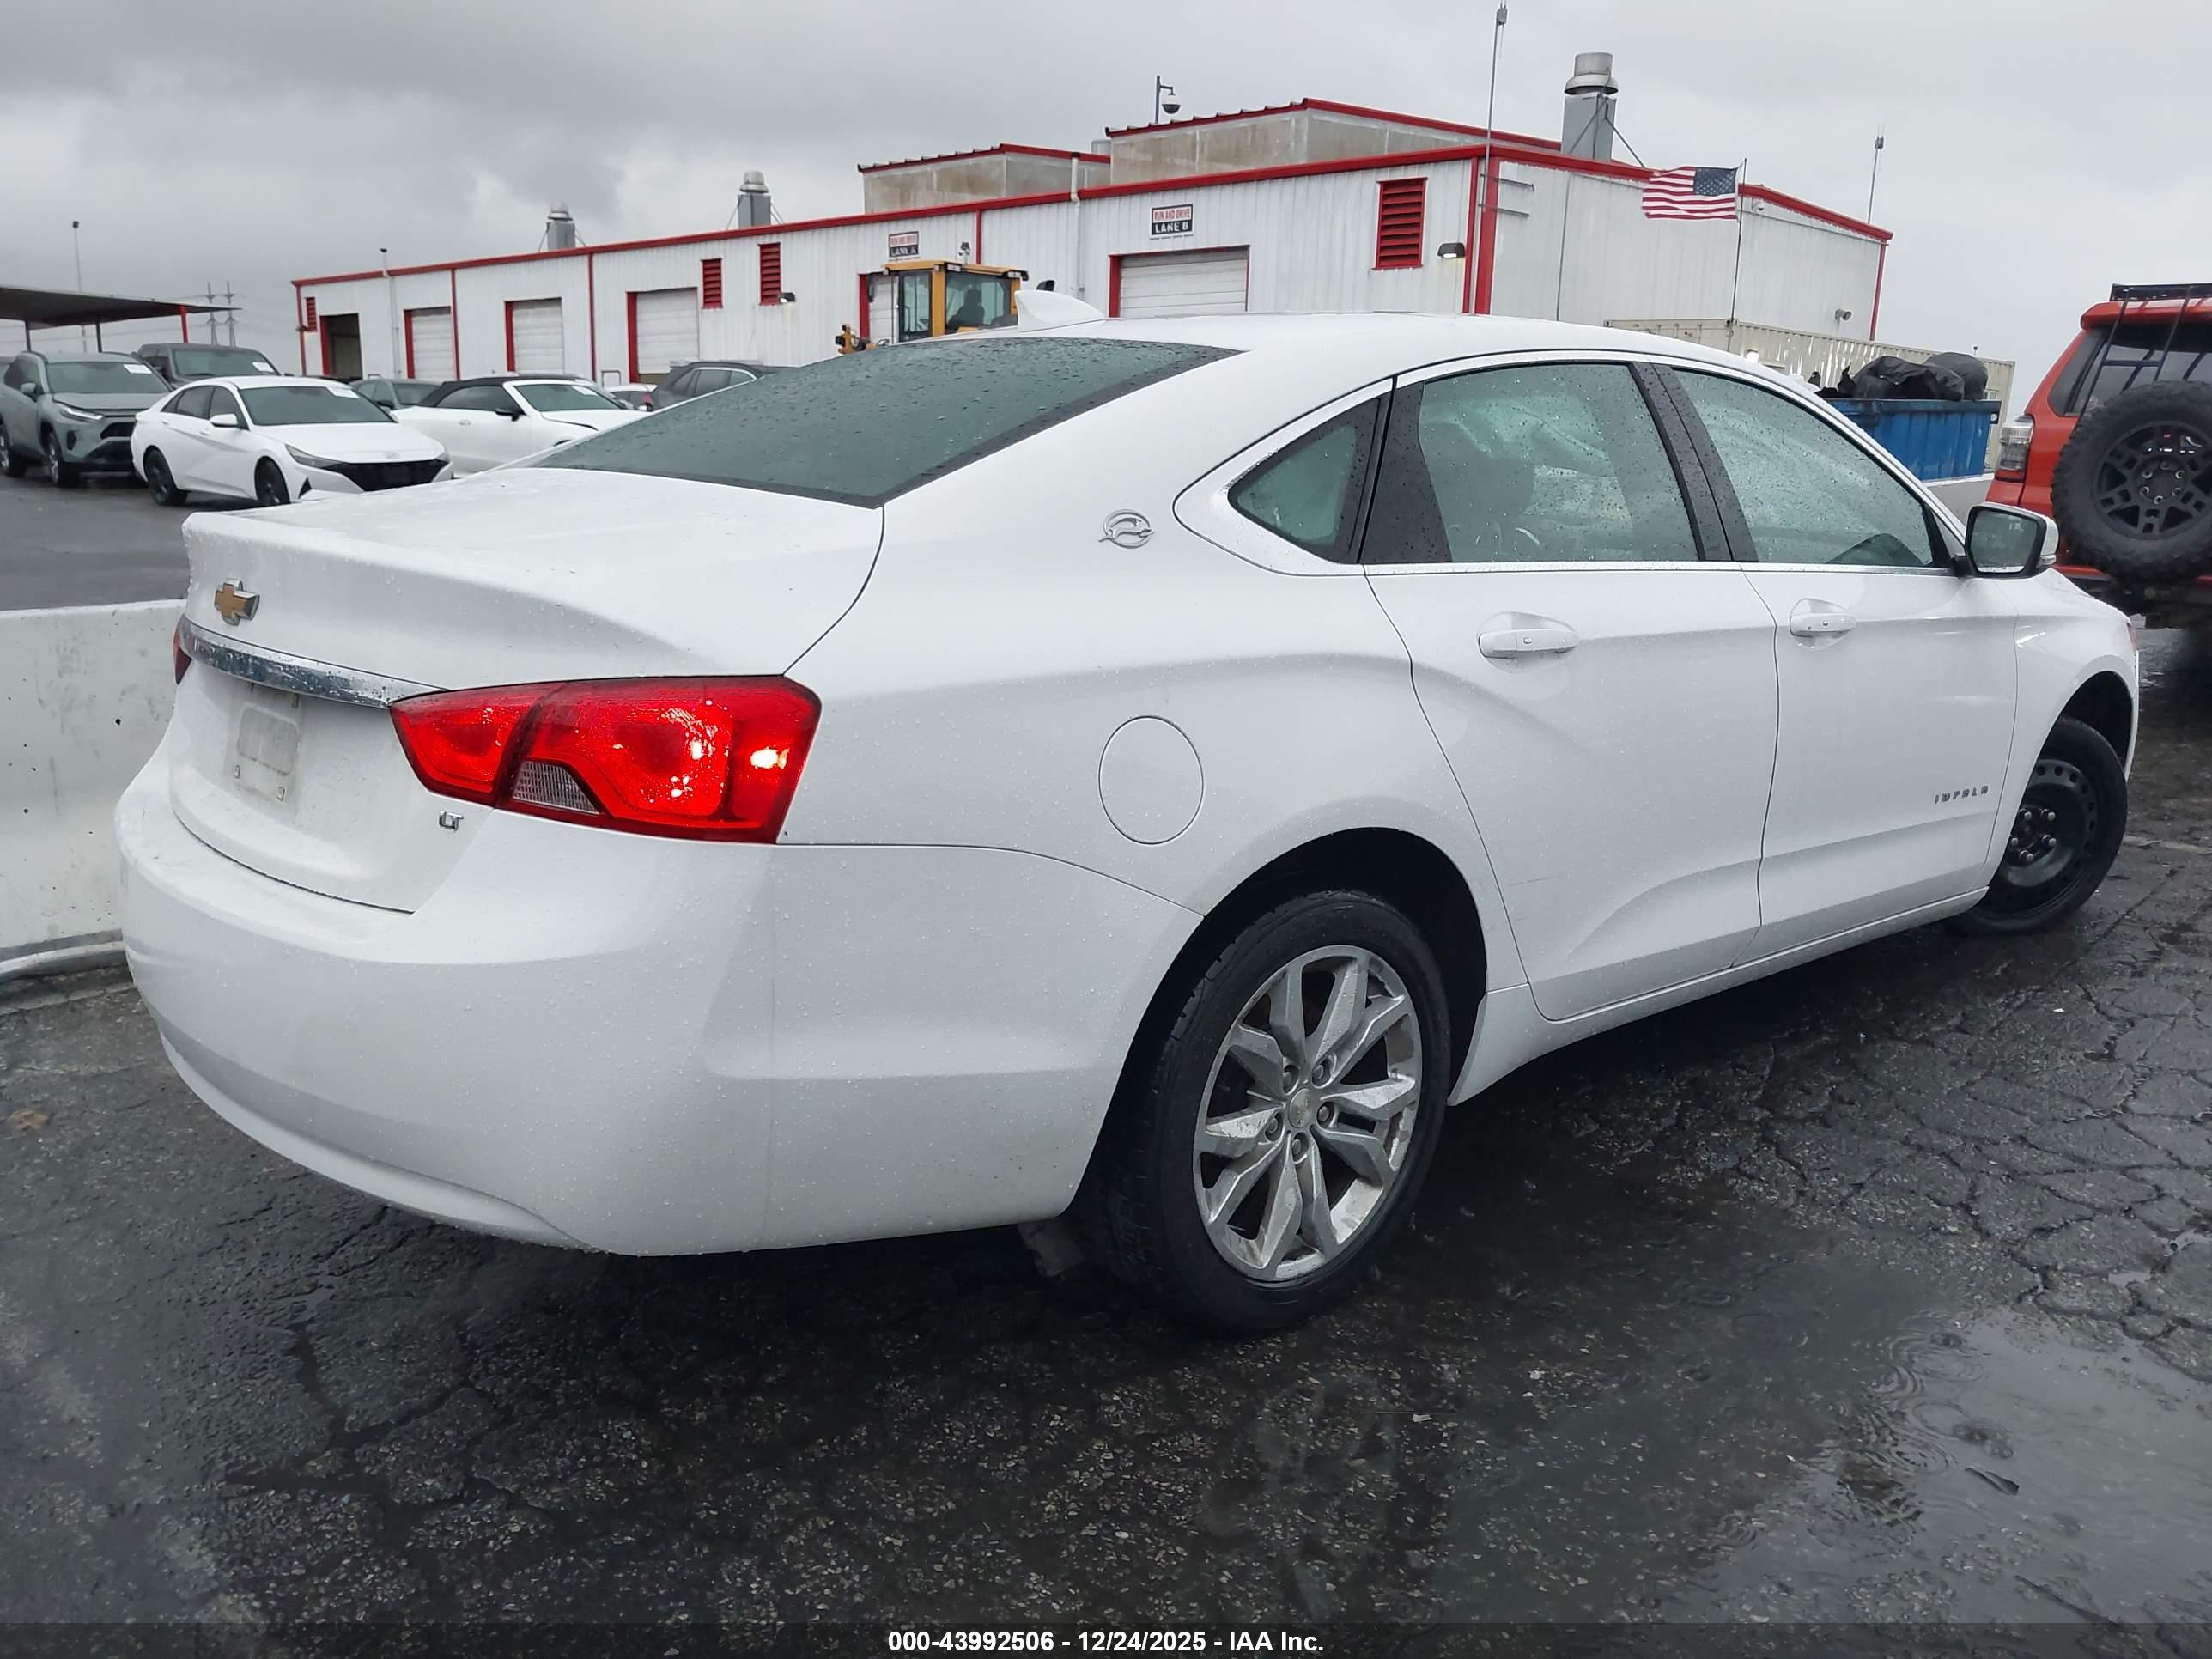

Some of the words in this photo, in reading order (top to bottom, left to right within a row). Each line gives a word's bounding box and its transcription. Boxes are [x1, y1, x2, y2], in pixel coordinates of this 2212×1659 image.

[1155, 222, 1180, 233] LANE
[1182, 221, 1189, 230] B
[1935, 785, 1989, 804] IMPALA
[439, 809, 465, 831] LT
